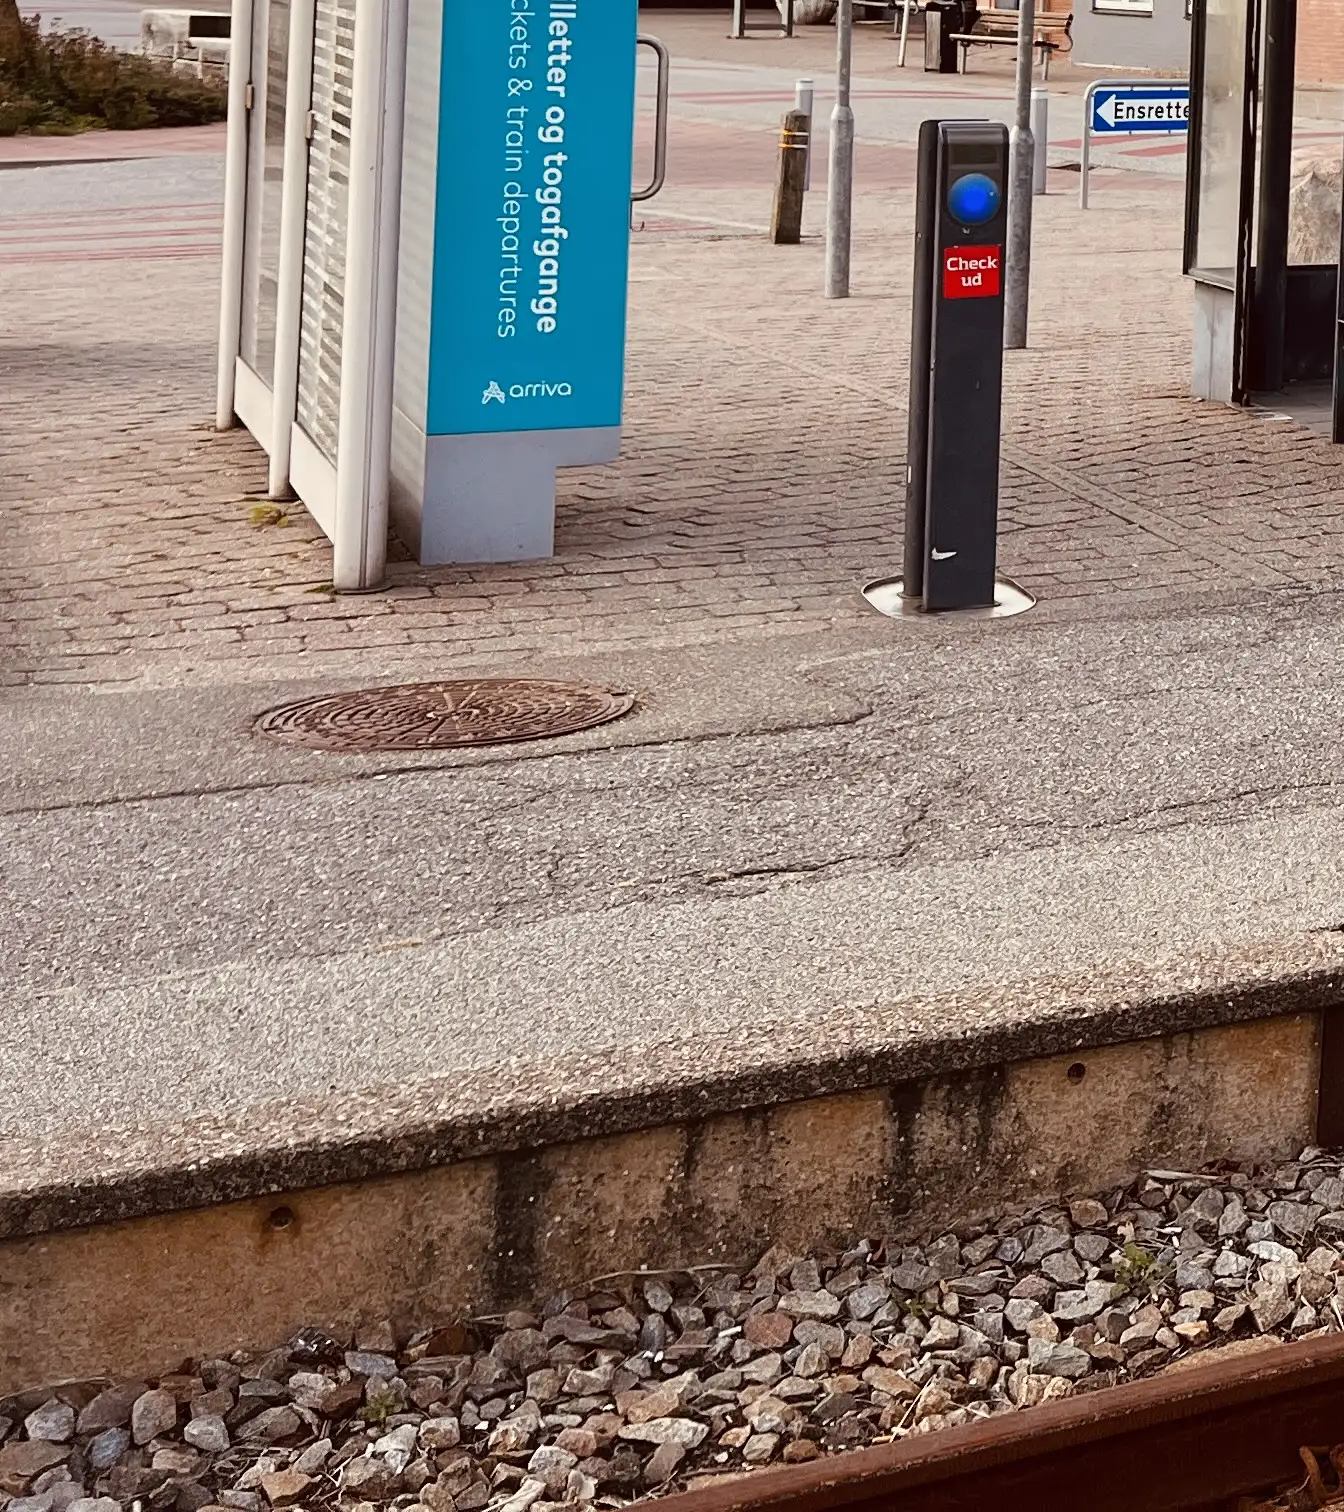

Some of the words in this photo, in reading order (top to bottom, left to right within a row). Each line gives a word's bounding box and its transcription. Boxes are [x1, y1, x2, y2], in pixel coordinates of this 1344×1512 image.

[507, 77, 533, 97] &
[504, 105, 530, 172] train
[537, 105, 565, 143] og
[530, 151, 569, 333] togafgange
[495, 181, 529, 338] departures
[946, 255, 999, 271] Check
[960, 272, 983, 287] ud
[509, 379, 572, 398] arriva
